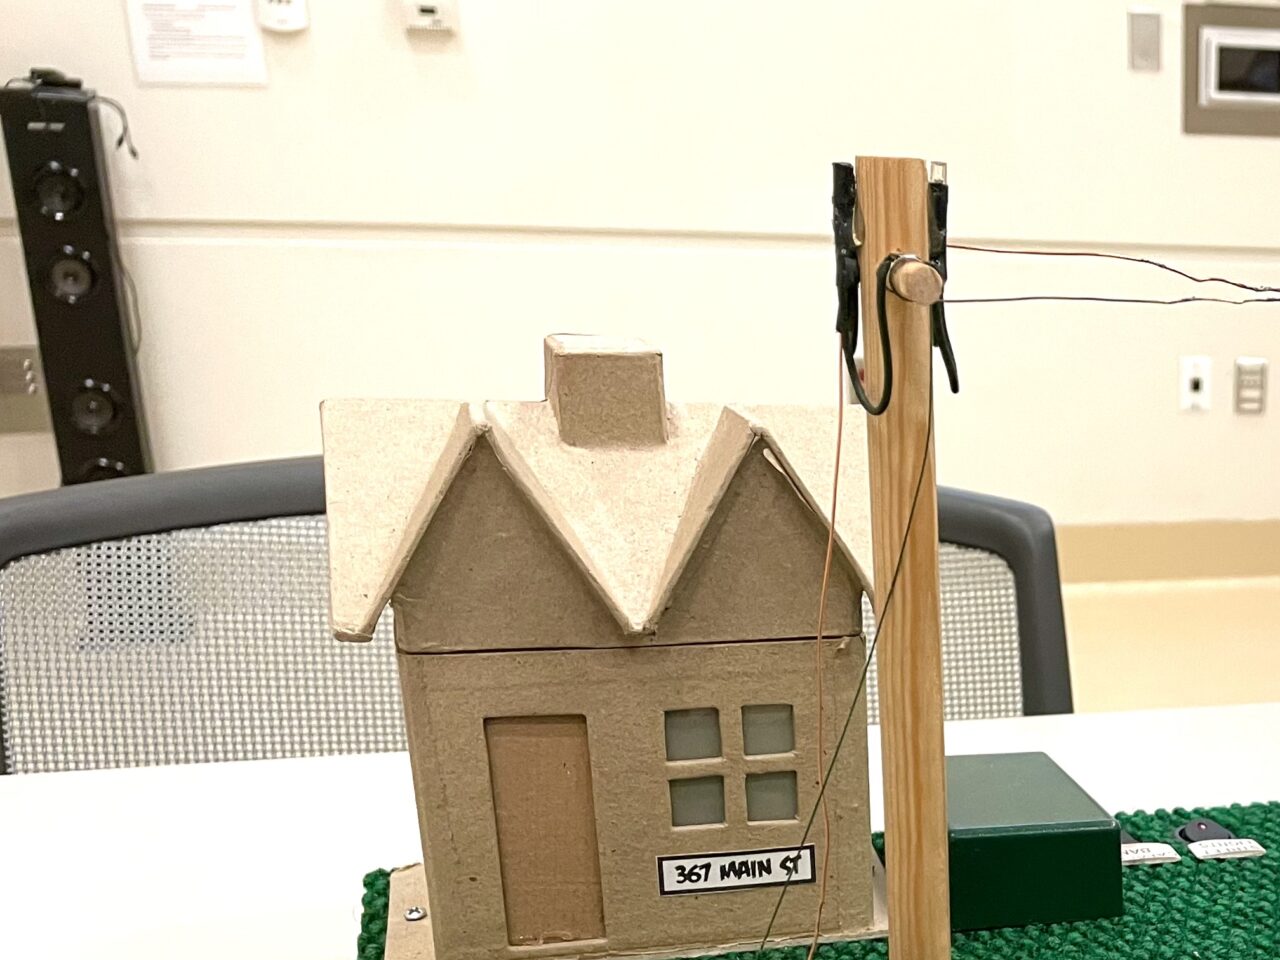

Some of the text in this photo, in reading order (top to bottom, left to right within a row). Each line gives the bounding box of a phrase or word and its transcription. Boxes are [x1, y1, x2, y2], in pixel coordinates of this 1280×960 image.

[674, 854, 802, 884] 367 MAIN ST
